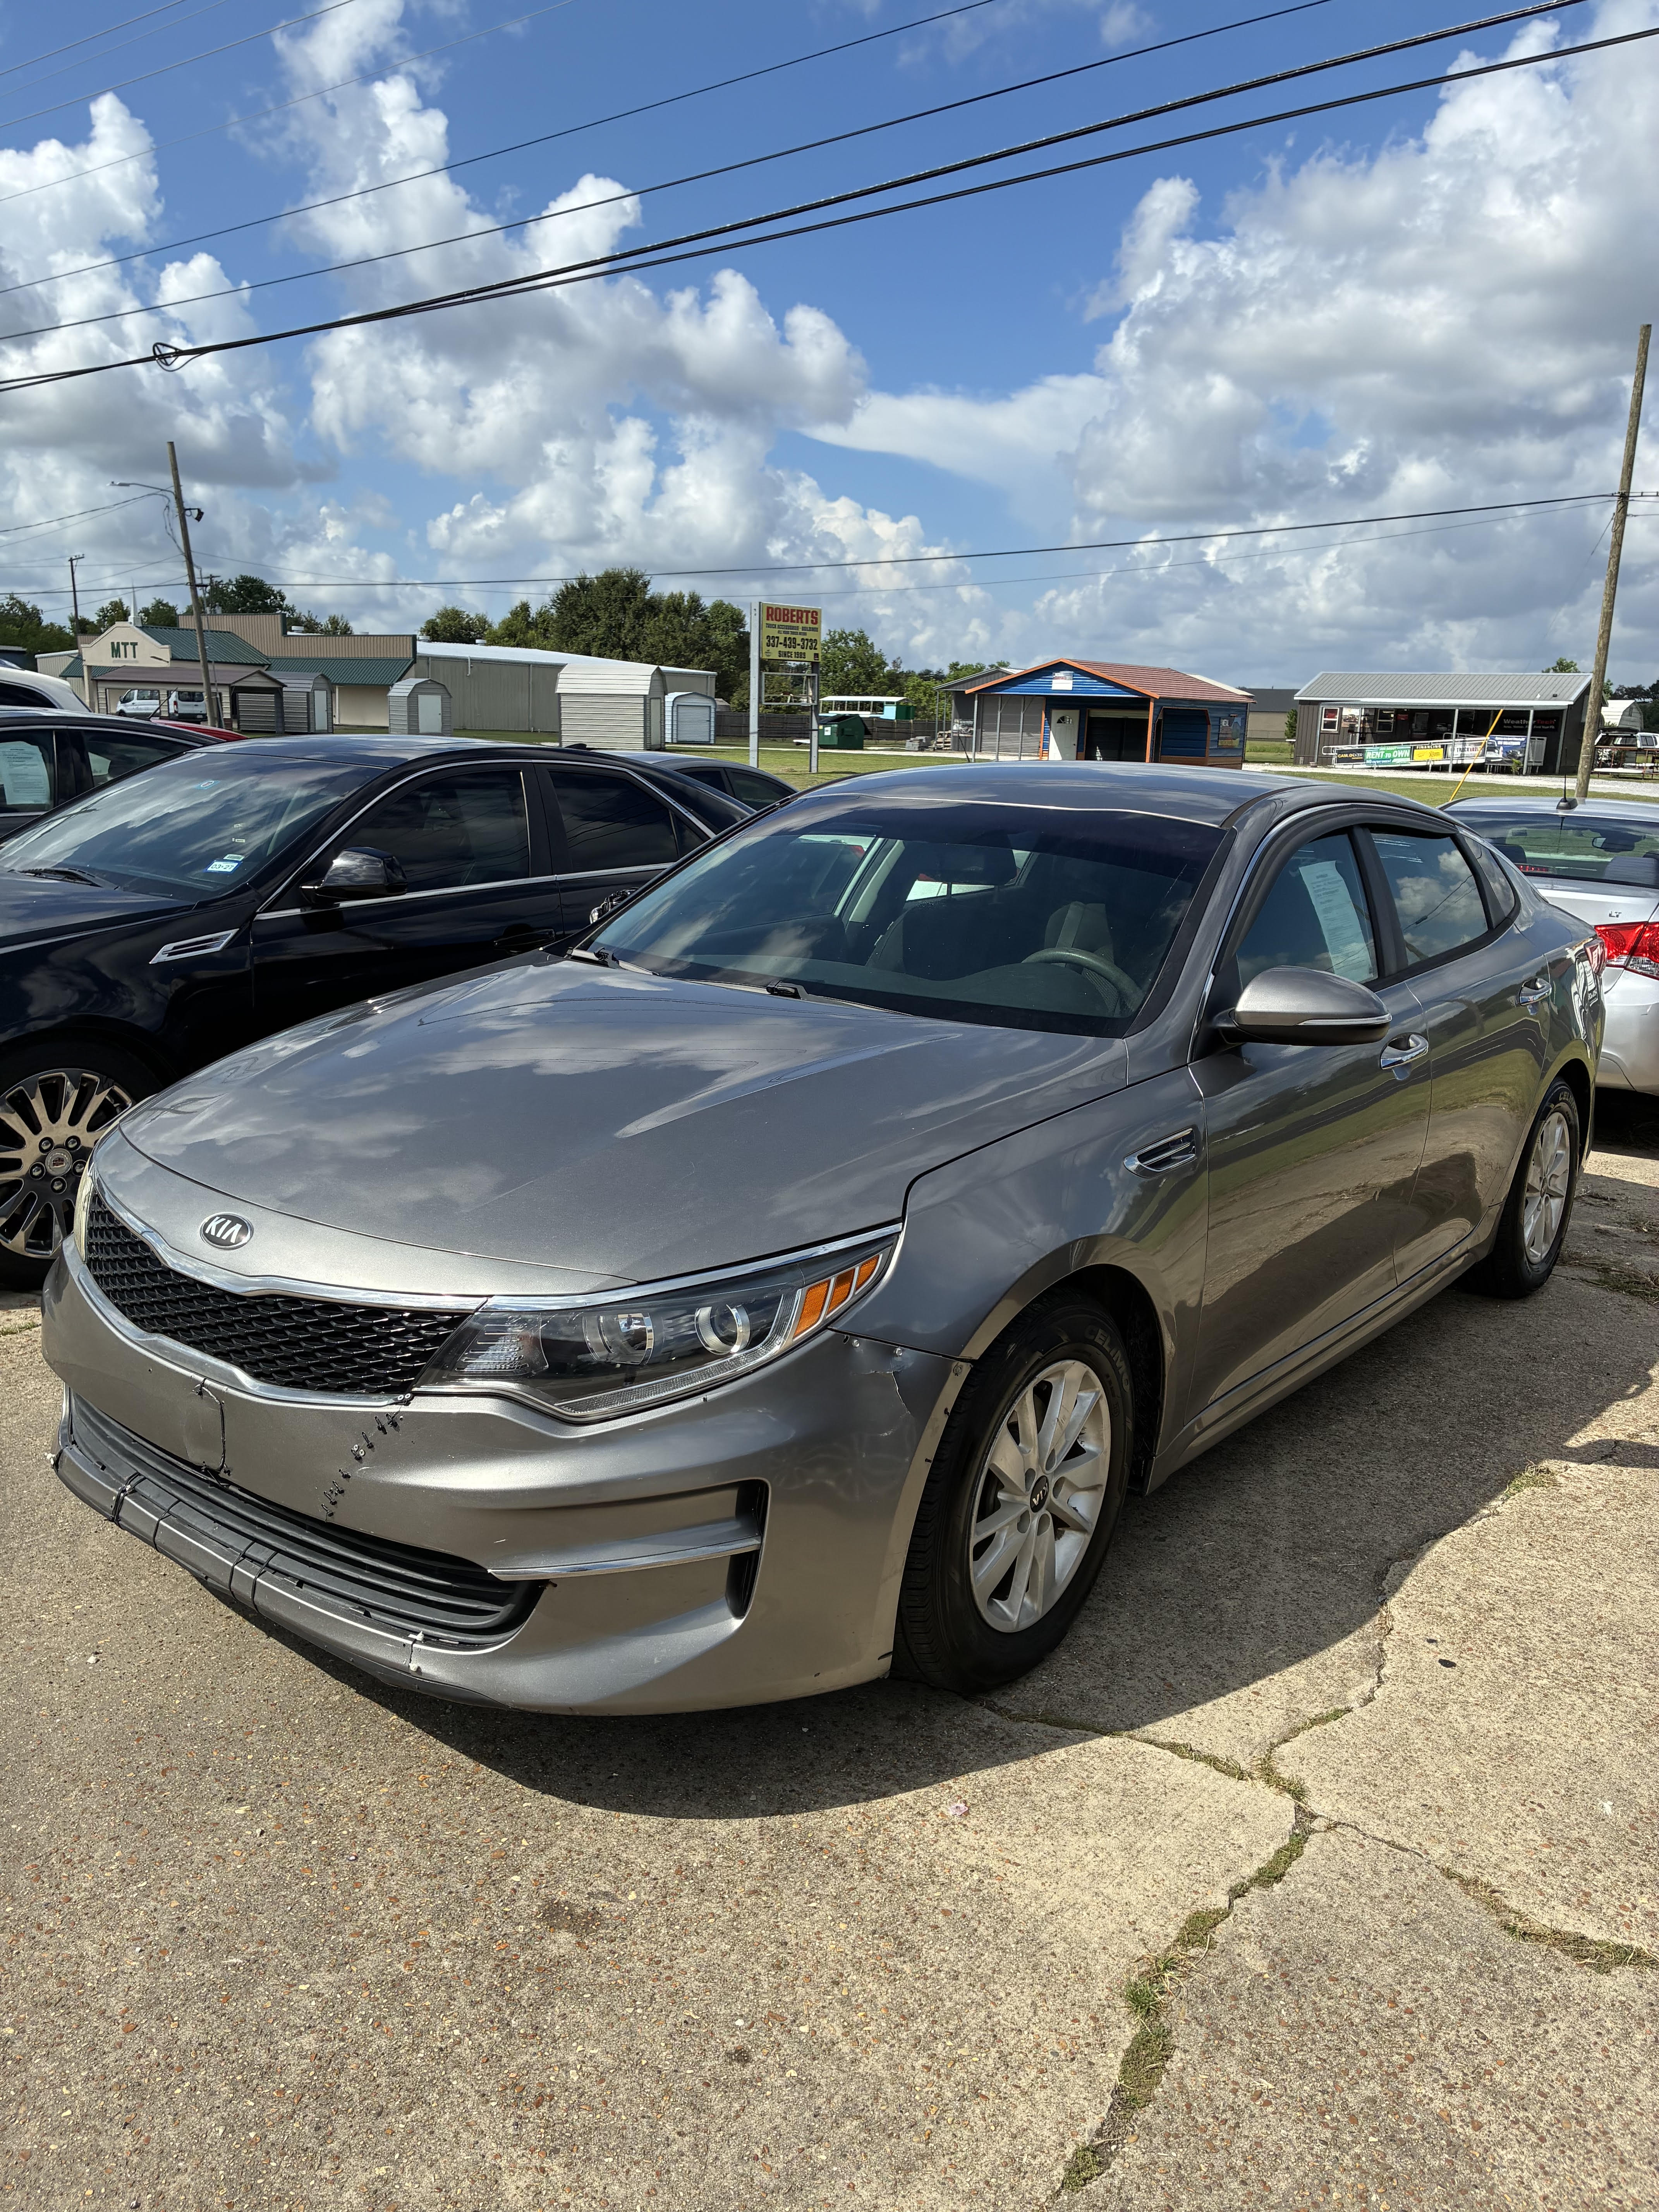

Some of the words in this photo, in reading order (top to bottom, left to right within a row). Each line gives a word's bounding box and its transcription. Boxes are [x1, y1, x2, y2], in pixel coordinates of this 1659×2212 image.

[766, 606, 819, 625] ROBERTS
[111, 641, 138, 659] MTT
[766, 635, 817, 650] 337-439-3732
[1366, 751, 1385, 759] RENT
[205, 1216, 242, 1243] KIA
[1085, 1325, 1130, 1392] CELIMO
